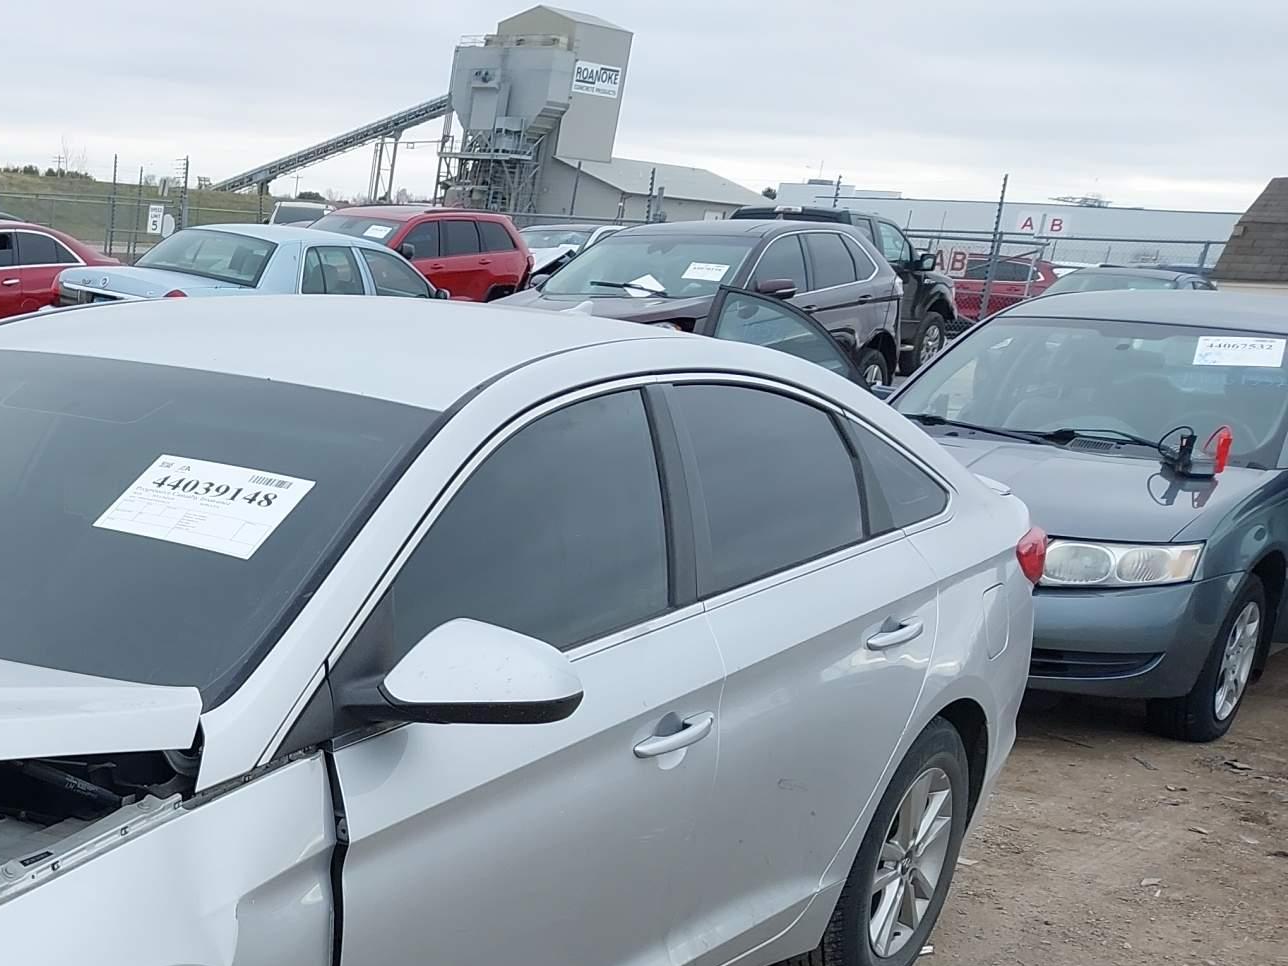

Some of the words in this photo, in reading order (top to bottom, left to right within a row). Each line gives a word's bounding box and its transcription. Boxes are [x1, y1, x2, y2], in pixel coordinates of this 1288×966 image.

[576, 66, 619, 85] ROANOKE
[151, 220, 158, 231] 5
[1021, 216, 1034, 230] A
[1050, 218, 1063, 232] B
[934, 249, 945, 271] A
[951, 251, 967, 272] B
[152, 475, 278, 507] 44039148
